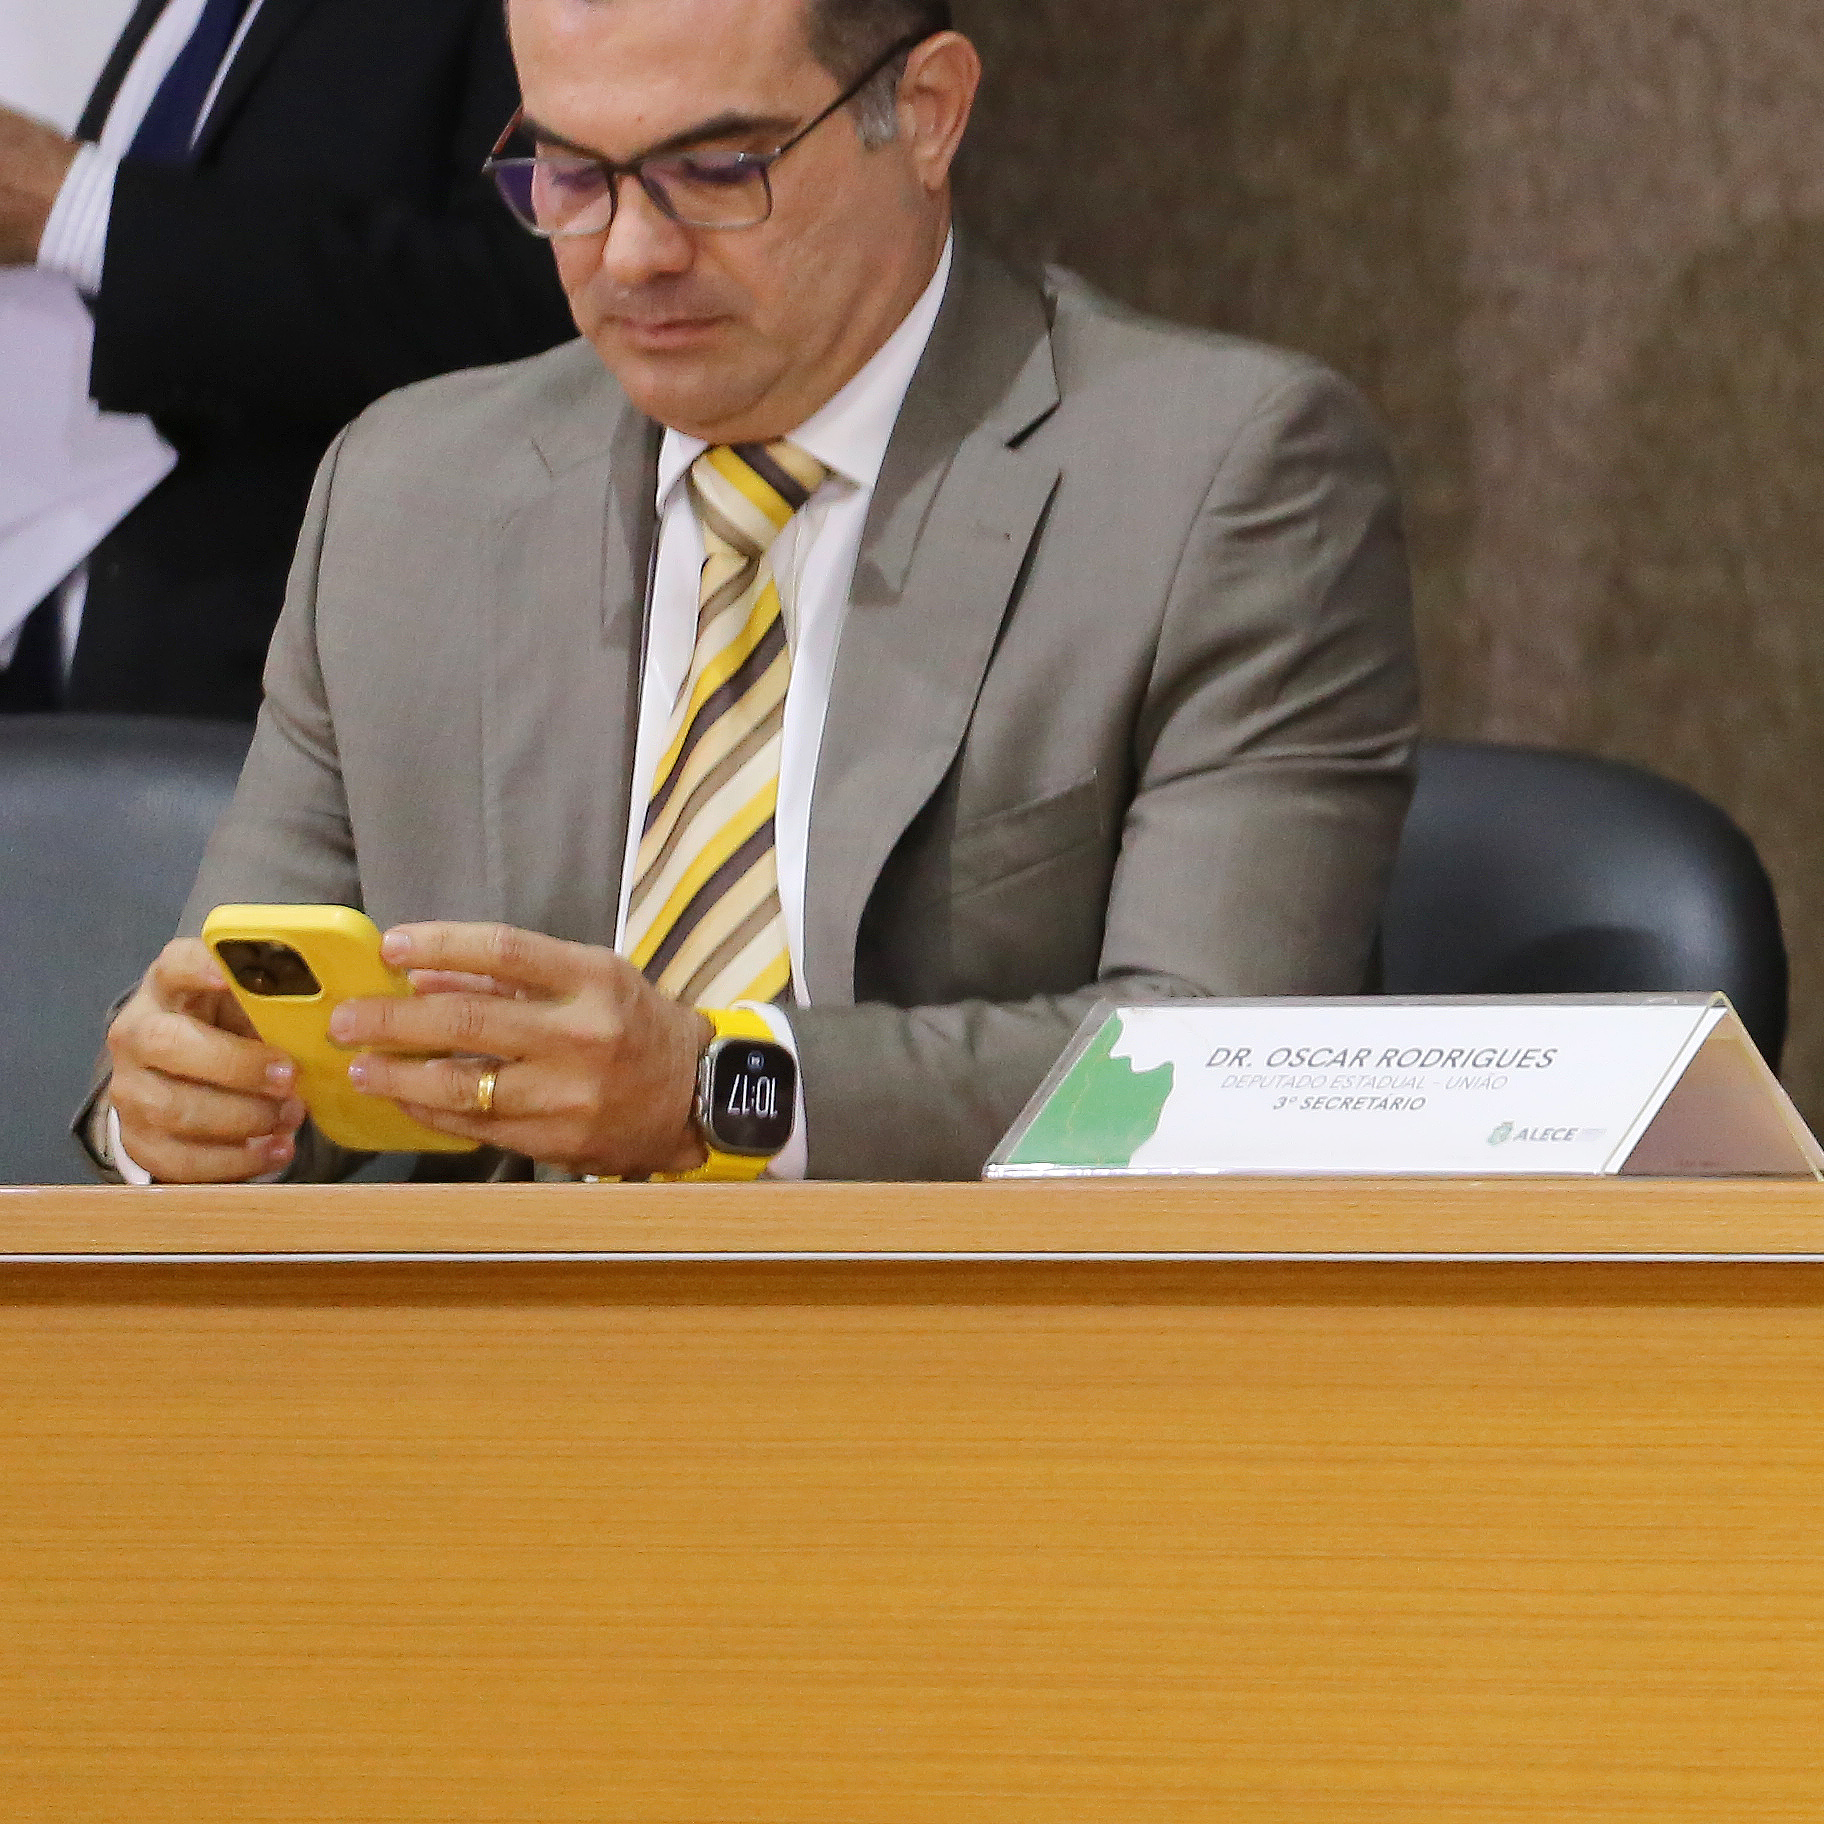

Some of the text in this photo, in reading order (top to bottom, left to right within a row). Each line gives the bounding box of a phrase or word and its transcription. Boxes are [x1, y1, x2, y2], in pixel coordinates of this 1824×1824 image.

[1206, 1047, 1558, 1068] DR. OSCAR RODRIGUES
[1221, 1075, 1328, 1089] DEPUTADO
[1330, 1075, 1425, 1089] ESTADUAL
[727, 1074, 778, 1118] 10:17
[1300, 1093, 1427, 1110] SECRETÁRIO
[1513, 1127, 1579, 1142] ALECE
